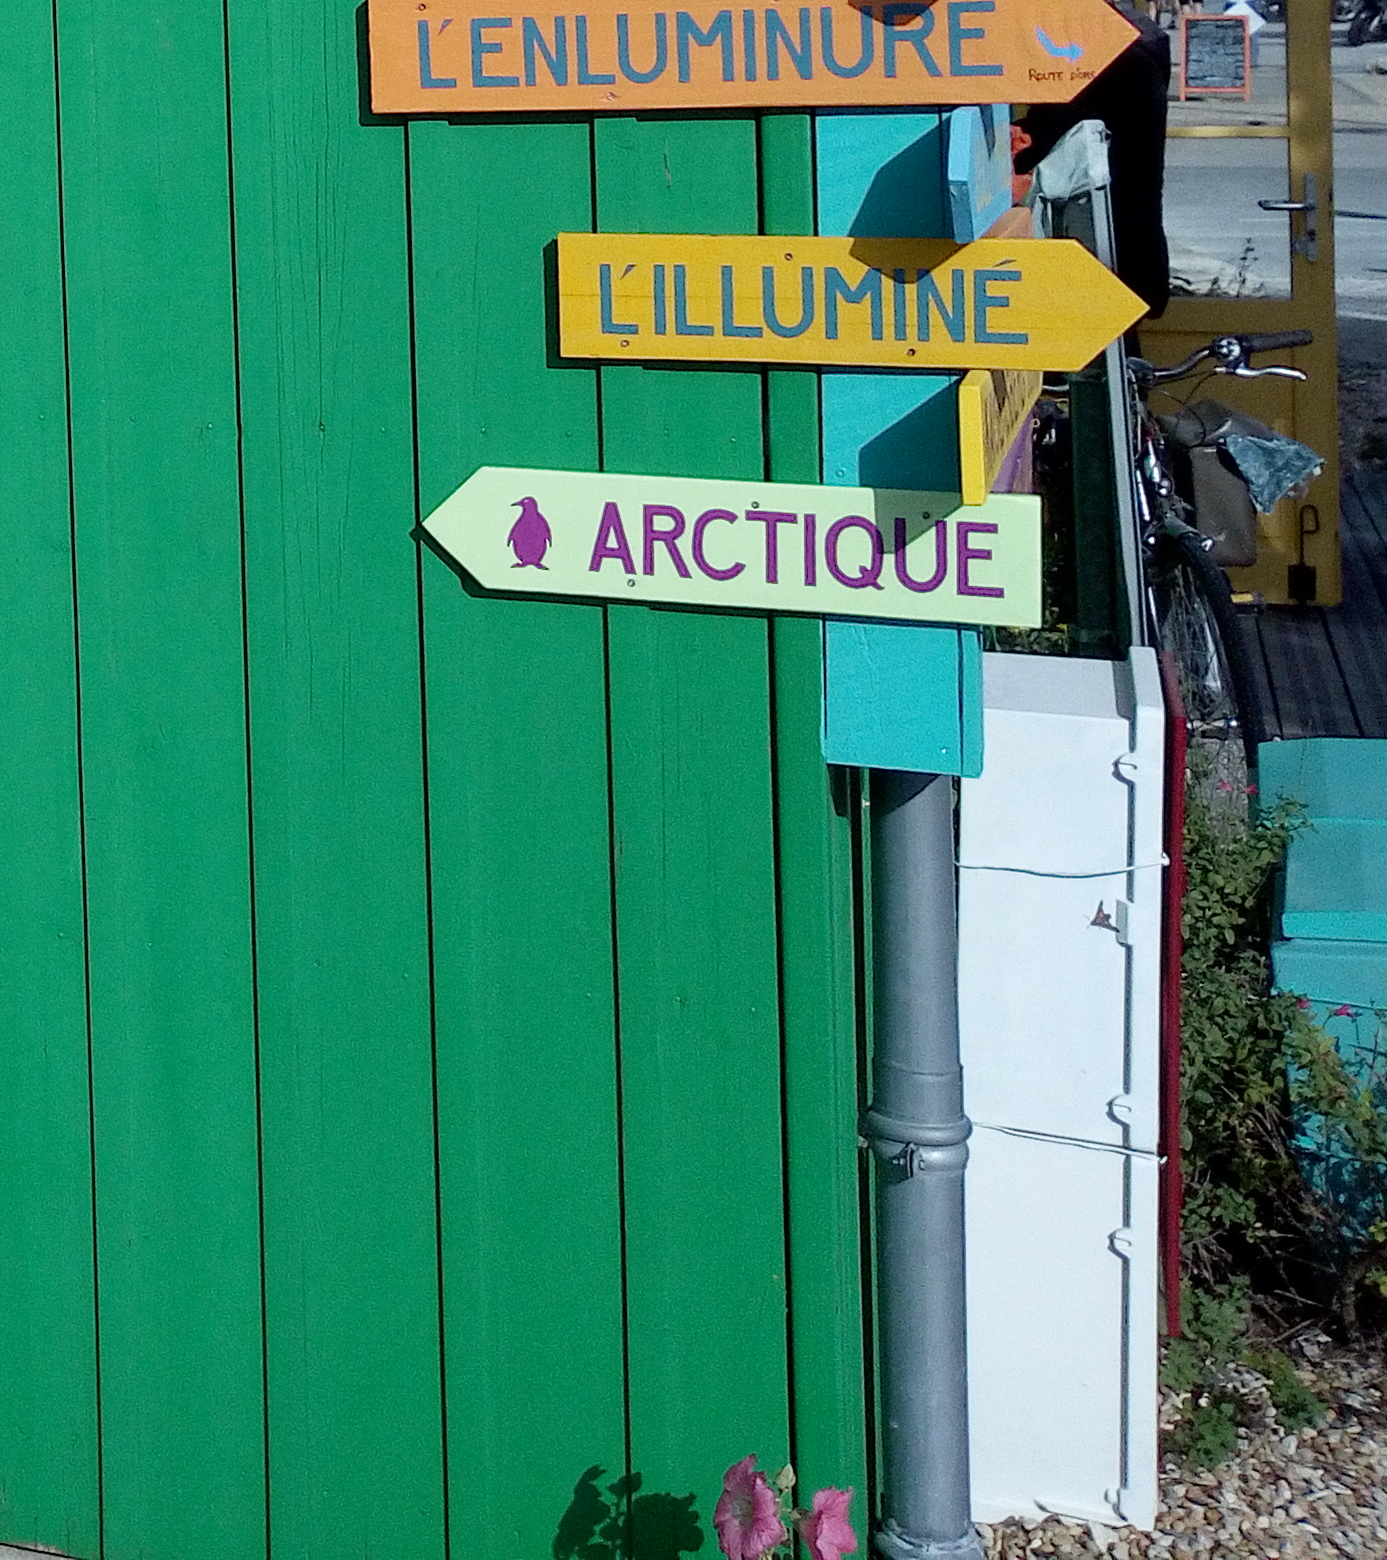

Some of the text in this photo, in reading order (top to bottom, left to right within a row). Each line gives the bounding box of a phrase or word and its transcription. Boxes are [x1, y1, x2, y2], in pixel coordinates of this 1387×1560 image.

[418, 0, 1005, 91] L'ENLUMINURE
[598, 259, 1029, 345] L'ILLUMINÉ
[588, 501, 1005, 599] ARCTIQUE
